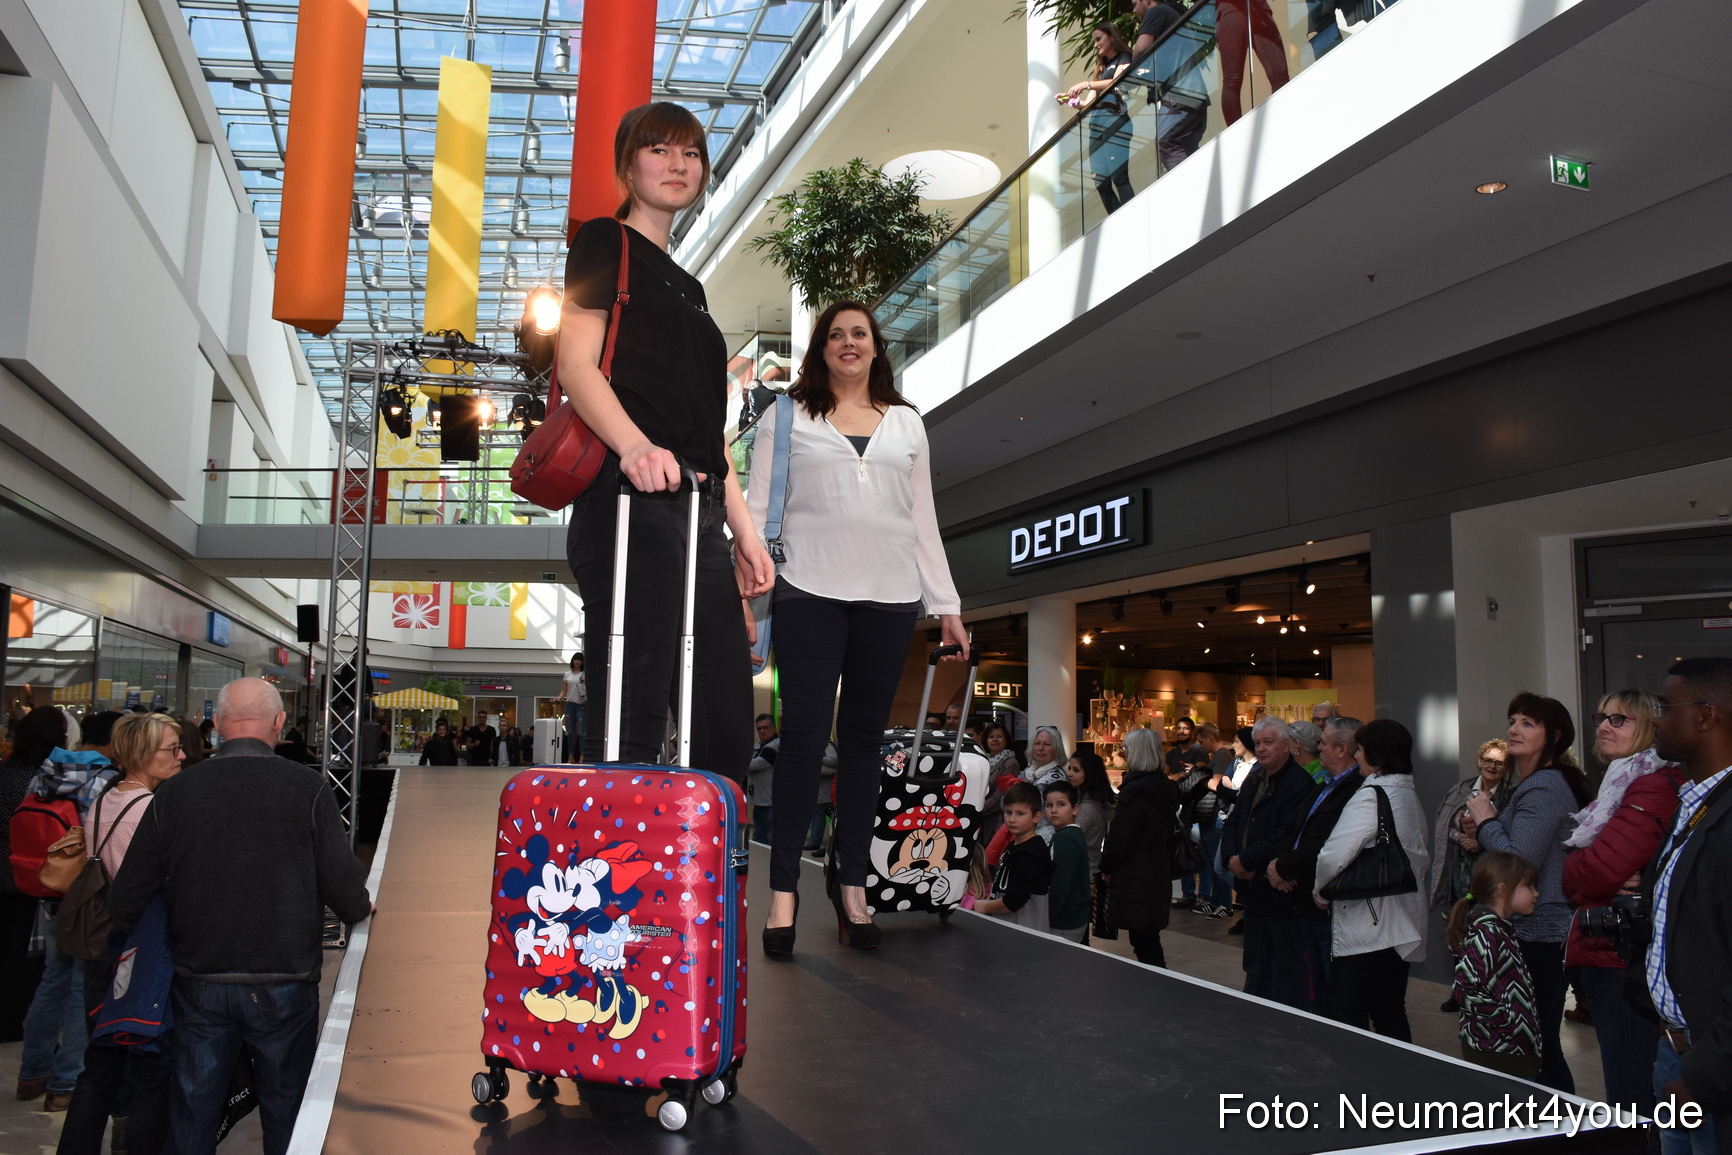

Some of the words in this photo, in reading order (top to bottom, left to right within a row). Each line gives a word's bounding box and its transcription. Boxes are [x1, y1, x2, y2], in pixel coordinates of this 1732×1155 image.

[1011, 496, 1130, 564] DEPOT
[974, 681, 1023, 696] EPOT
[630, 924, 673, 933] AMERICAN
